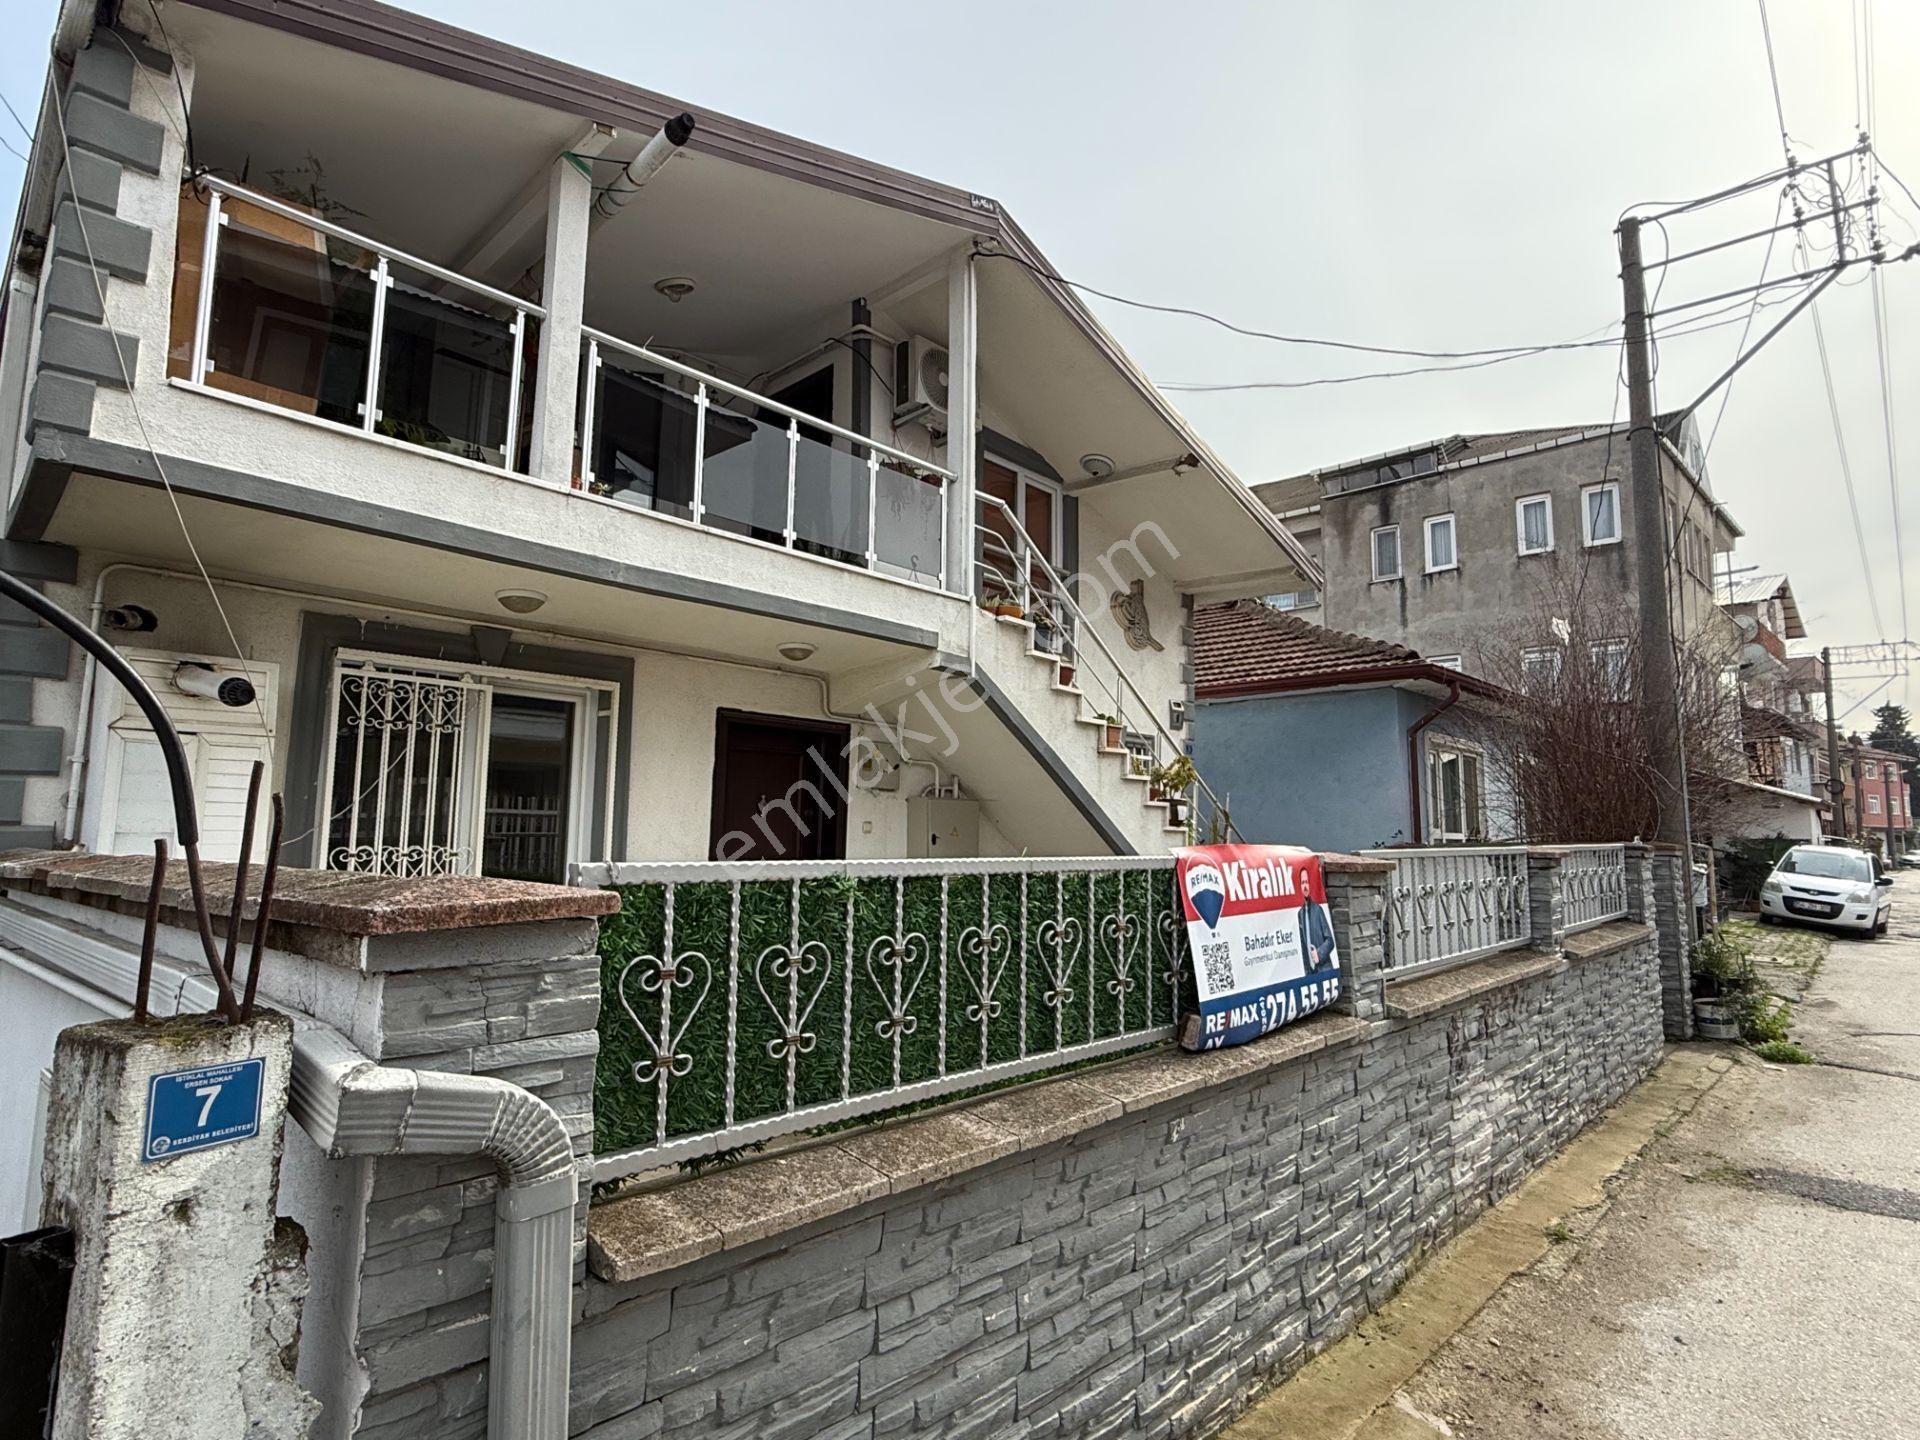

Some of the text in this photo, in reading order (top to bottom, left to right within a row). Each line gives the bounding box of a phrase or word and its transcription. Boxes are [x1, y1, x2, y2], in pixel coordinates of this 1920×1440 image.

[1190, 872, 1220, 888] RE/MAX
[1222, 857, 1295, 902] Kiralık
[1244, 930, 1294, 952] Bahadır Eker
[1205, 1002, 1259, 1035] RE/MAX
[1267, 989, 1297, 1031] 274
[1297, 983, 1319, 1019] 55
[1318, 977, 1339, 1010] 55
[206, 1065, 243, 1076] MAHALLESİ
[209, 1074, 233, 1084] SOKAK
[195, 1084, 222, 1127] 7
